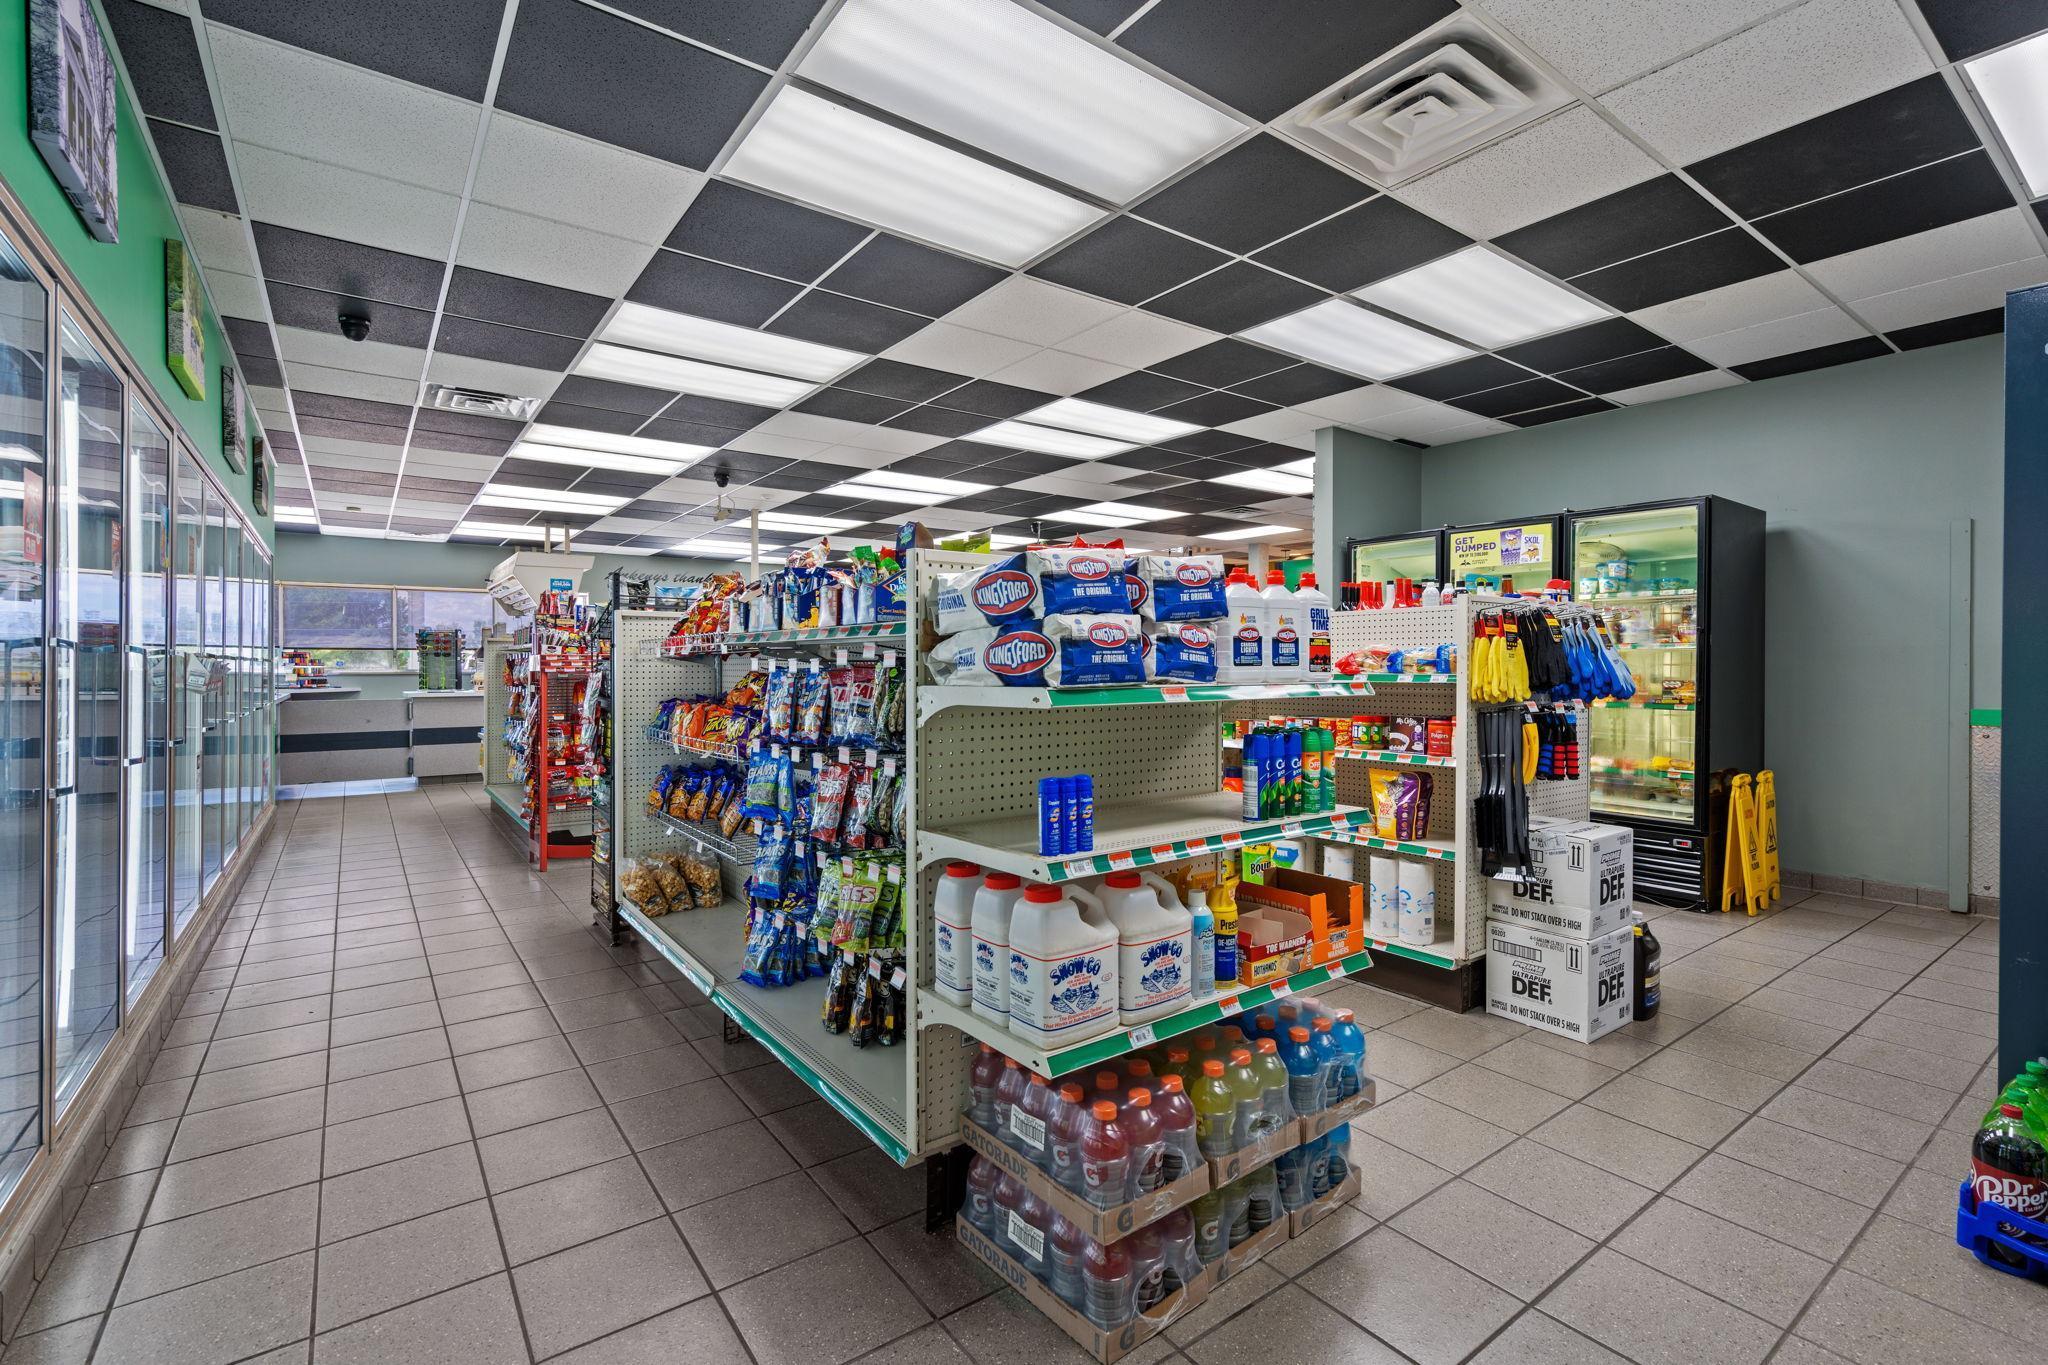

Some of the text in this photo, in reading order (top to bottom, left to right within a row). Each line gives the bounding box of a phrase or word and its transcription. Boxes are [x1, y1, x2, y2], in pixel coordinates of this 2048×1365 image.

[1455, 537, 1474, 545] GET
[1455, 542, 1496, 553] PUMPED
[1524, 536, 1540, 544] SKOL
[1071, 560, 1107, 576] KINGSFORD
[1179, 568, 1210, 582] KINGSFORD
[976, 578, 1030, 609] KINGSFORD
[1072, 587, 1112, 596] THE ORIGINAL
[1191, 592, 1213, 600] ORIGINAL
[1310, 608, 1329, 620] GRILL
[1311, 619, 1329, 630] TIME
[1091, 627, 1125, 643] KINGSFORD
[989, 639, 1046, 669] KINGSFORD
[1092, 654, 1128, 663] THE ORIGINAL
[1180, 652, 1189, 660] THE
[1189, 654, 1209, 664] ORIGINAL
[748, 764, 778, 779] GIANTS
[1600, 864, 1625, 878] ULTRAPURE
[1512, 881, 1553, 903] DEF
[1600, 872, 1625, 906] DEF
[1511, 908, 1582, 931] DO NOT STACK OVER 5 HIGH
[1266, 935, 1306, 954] TOE WARMERS
[1328, 946, 1350, 958] WARMERS
[1332, 940, 1345, 949] HAND
[1140, 940, 1183, 967] SNOW-GO
[1050, 956, 1101, 986] SNOW-GO
[1253, 960, 1278, 977] HOTHANDS
[1599, 962, 1625, 980] ULTRAPURE
[1512, 970, 1552, 985] ULTRAPURE
[1512, 976, 1552, 1002] DEF
[1598, 971, 1624, 1008] DEF
[1510, 1004, 1580, 1033] DO NOT STACK OVER 5 HIGH
[962, 1123, 1028, 1183] GATORADE
[1976, 1175, 2048, 1213] Pepper
[2002, 1178, 2034, 1196] Dr
[1117, 1207, 1134, 1233] G
[960, 1225, 1028, 1292] GATORADE
[1118, 1324, 1136, 1351] G
